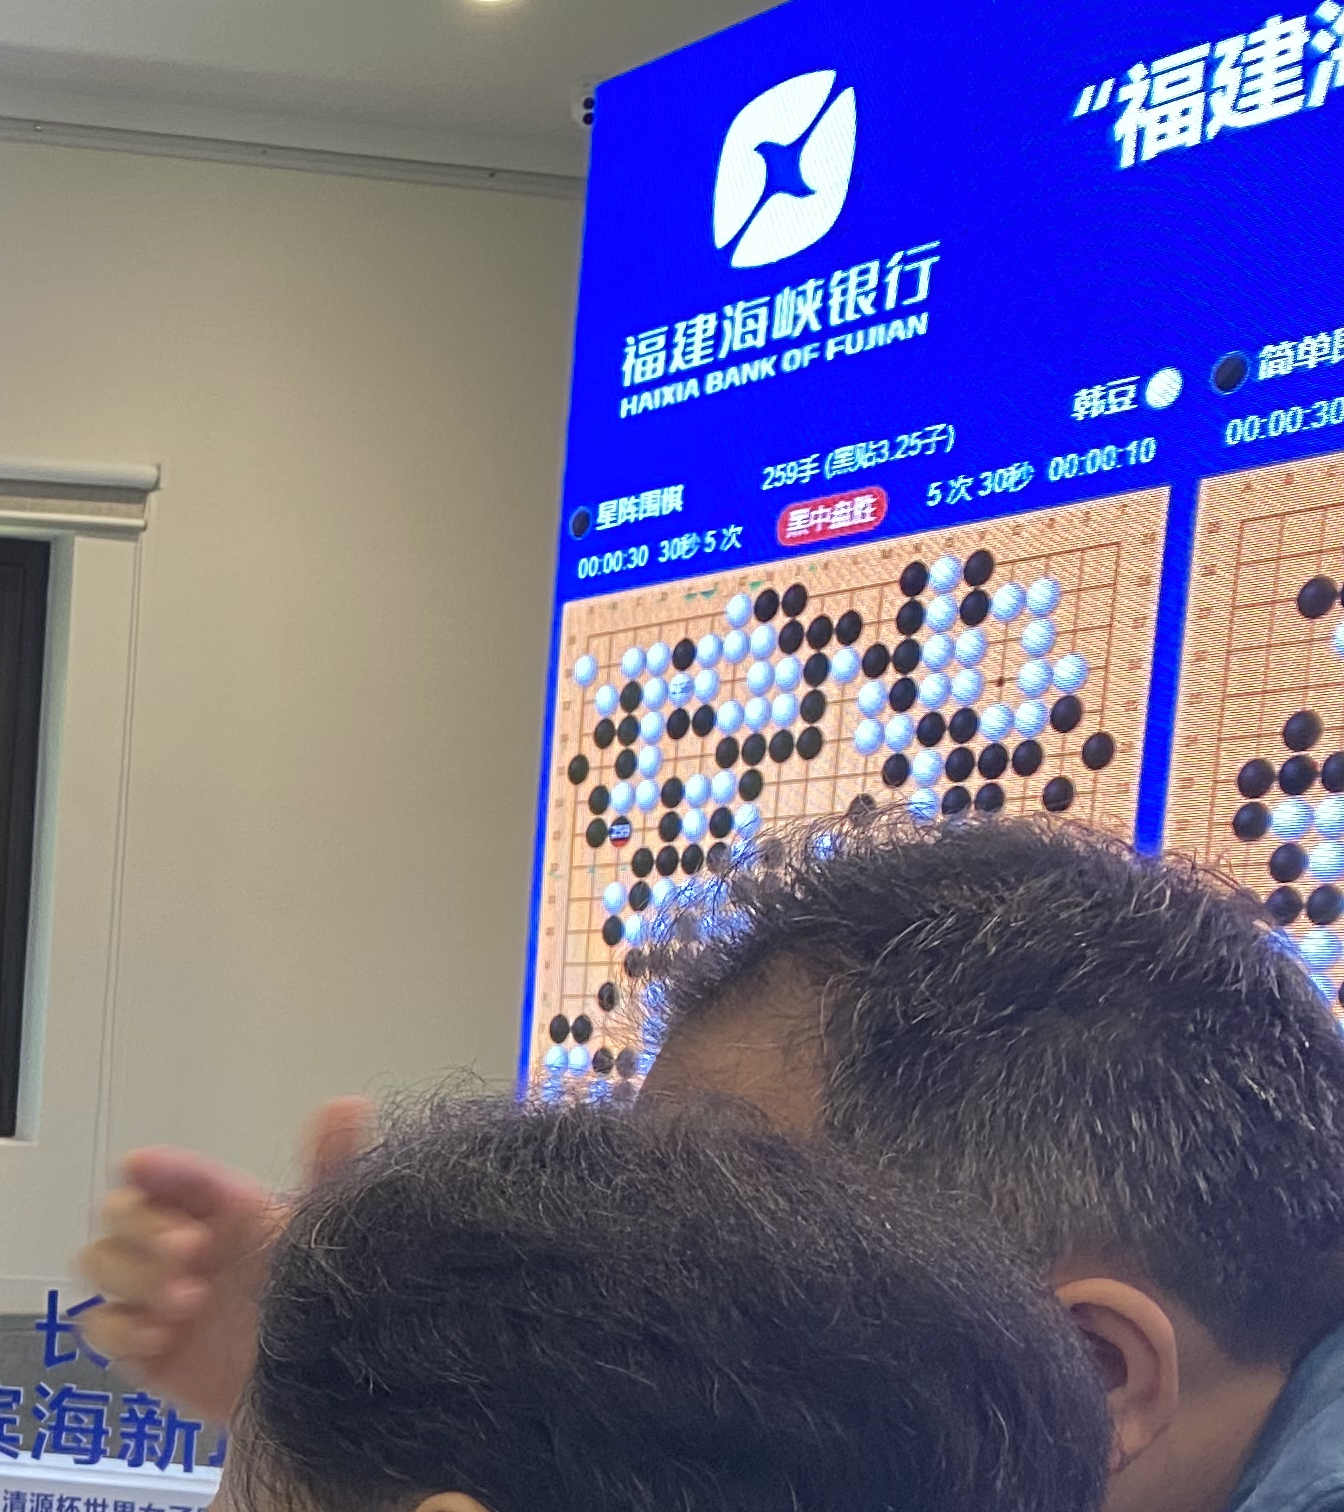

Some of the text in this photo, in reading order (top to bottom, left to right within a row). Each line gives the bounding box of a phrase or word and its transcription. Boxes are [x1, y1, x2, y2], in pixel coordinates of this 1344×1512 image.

[622, 240, 941, 387] 福建海峡银行
[619, 312, 929, 419] HAIXIA BANK OF FUJIAN
[1070, 376, 1141, 421] 韩豆
[761, 453, 821, 490] 259手
[1048, 437, 1157, 483] 00:00:10
[595, 485, 684, 531] 星阵围棋
[578, 545, 649, 579] 00:00:30
